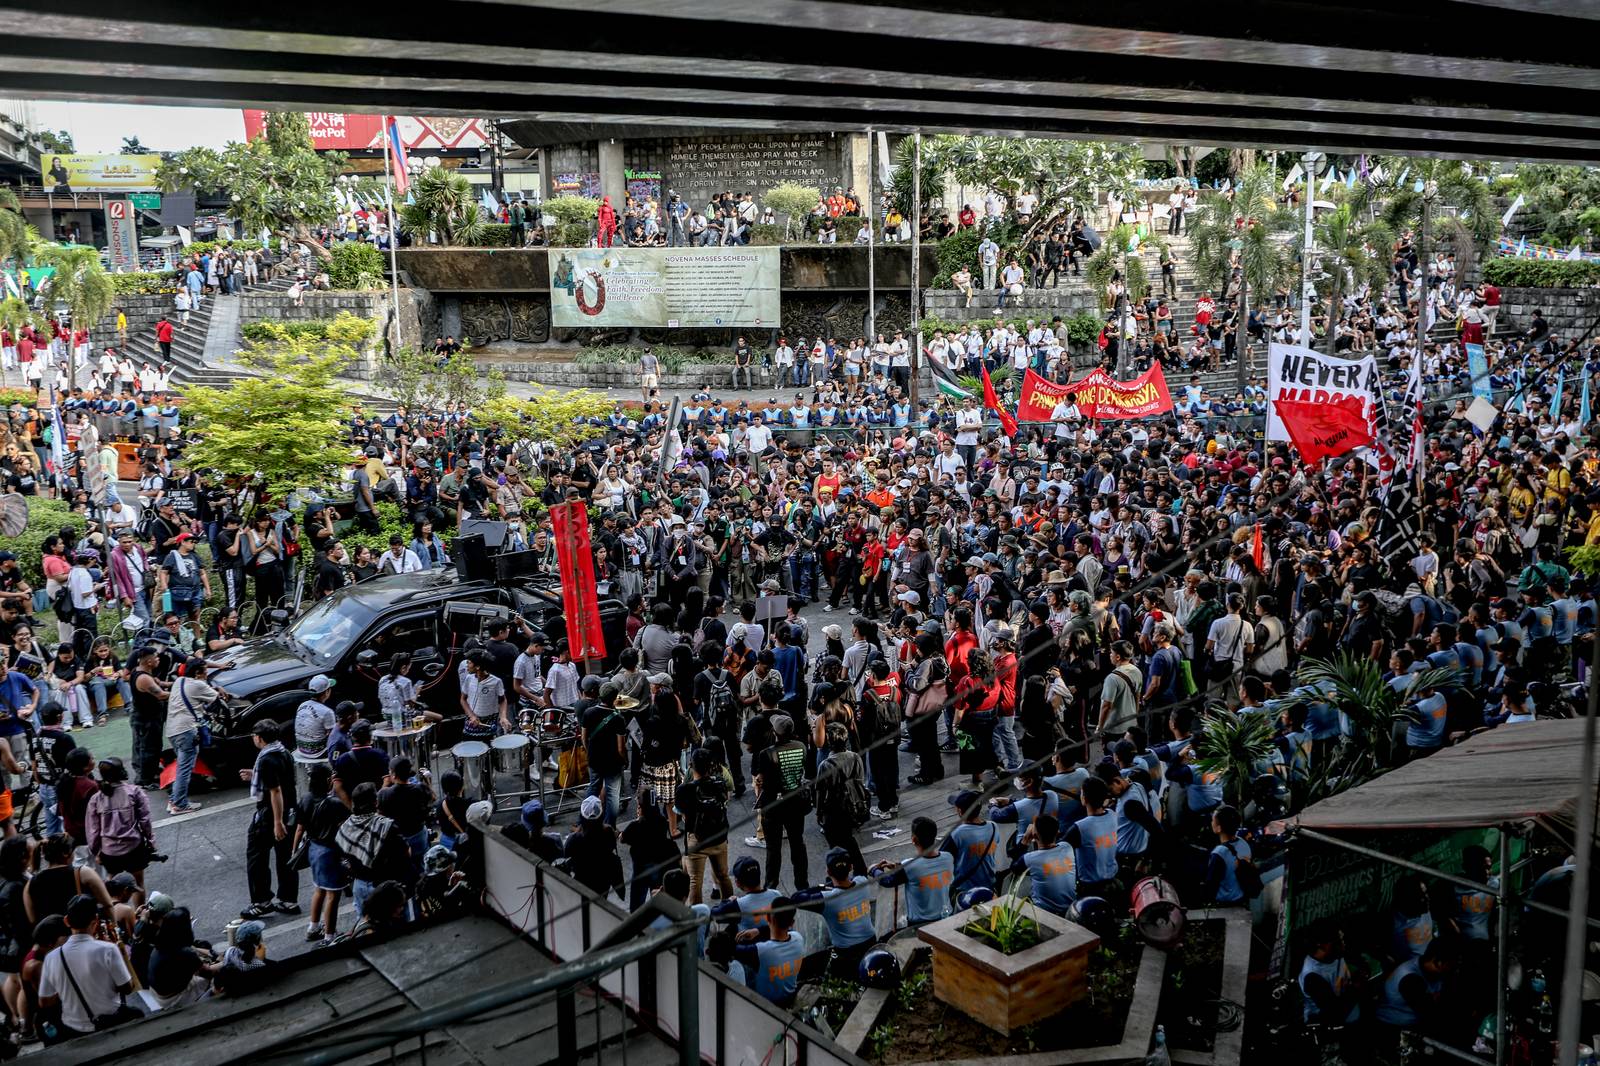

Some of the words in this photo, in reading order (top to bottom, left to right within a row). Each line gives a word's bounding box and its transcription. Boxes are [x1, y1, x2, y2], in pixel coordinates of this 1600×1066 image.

[309, 128, 327, 138] Hot
[327, 127, 345, 138] Pot
[748, 142, 766, 150] CALL
[741, 160, 760, 168] FROM
[786, 160, 812, 168] WICKED
[810, 168, 825, 176] AND
[606, 278, 649, 286] Celebrating
[1280, 354, 1362, 390] NEVER
